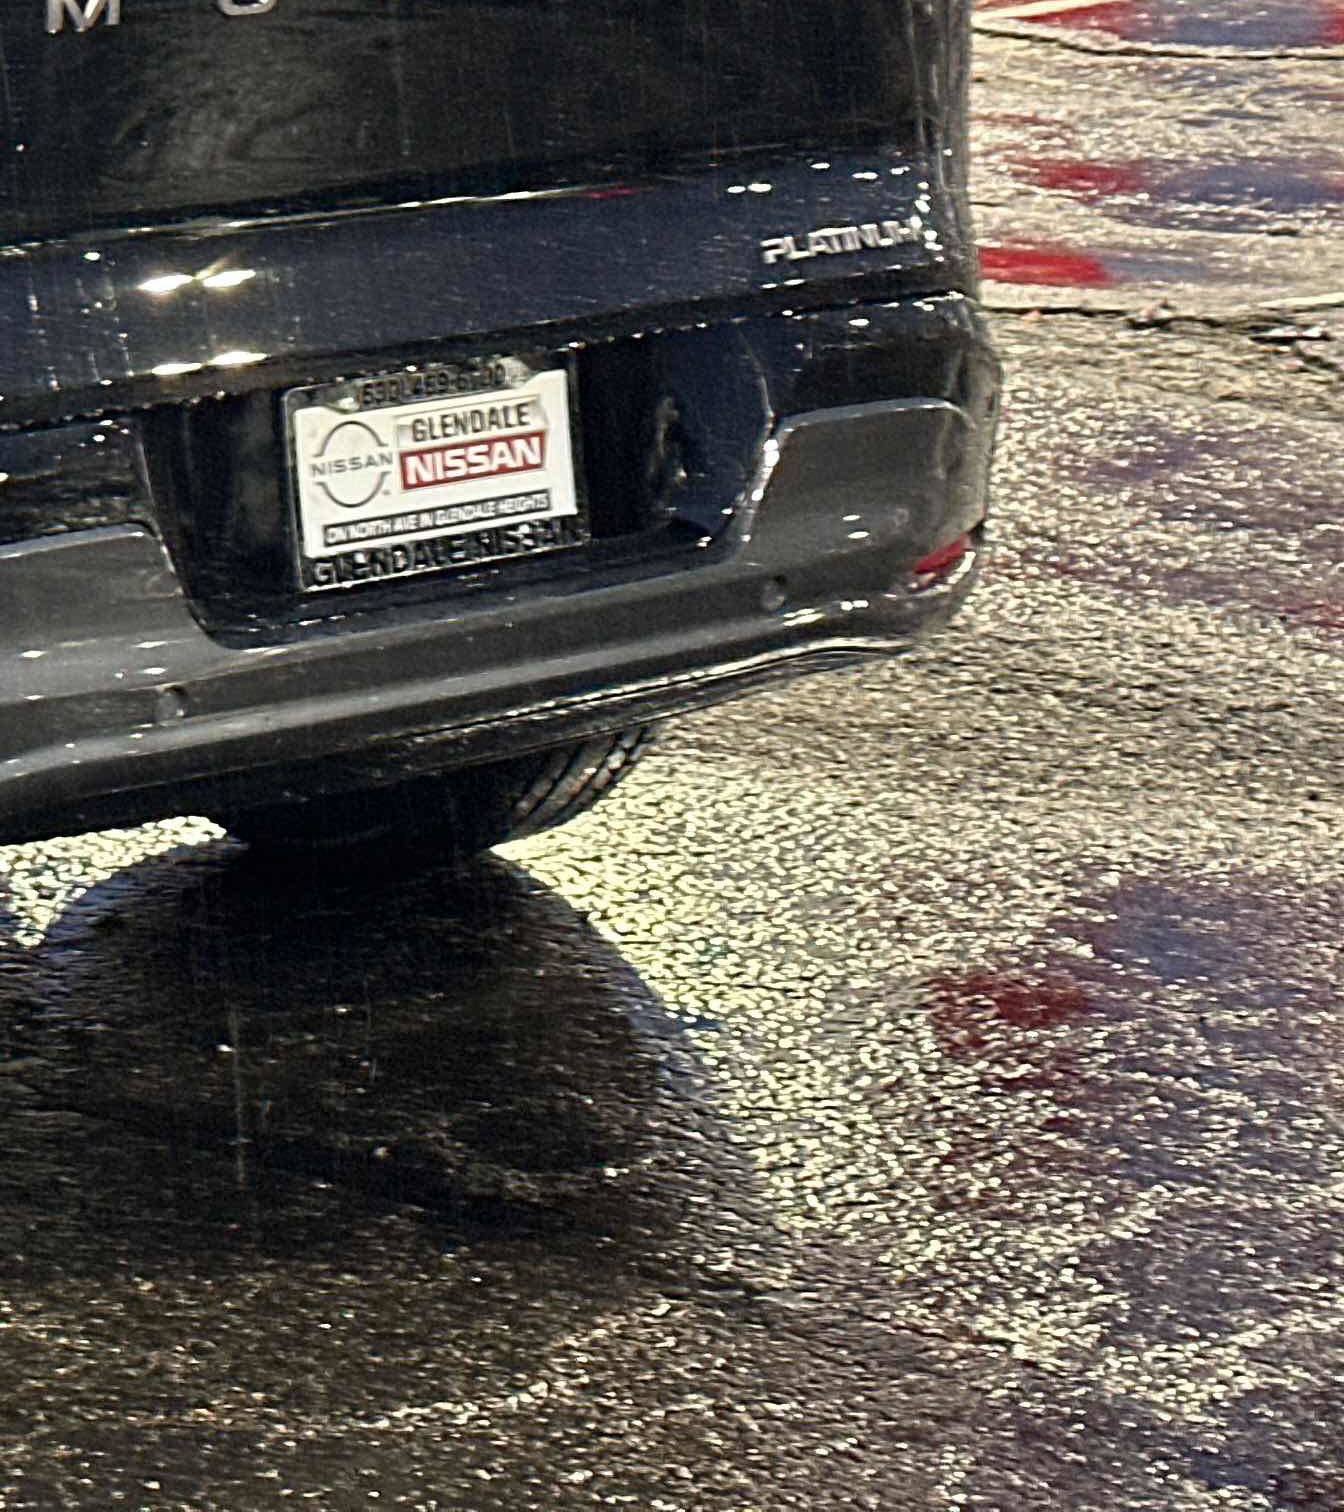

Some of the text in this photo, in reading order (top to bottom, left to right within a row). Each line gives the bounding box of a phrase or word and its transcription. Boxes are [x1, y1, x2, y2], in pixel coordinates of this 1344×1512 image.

[760, 217, 924, 264] PLATINUM
[411, 401, 530, 443] GLENDALE
[311, 451, 394, 478] NISSAN
[405, 436, 542, 485] NISSAN
[434, 500, 497, 527] GLENDALE
